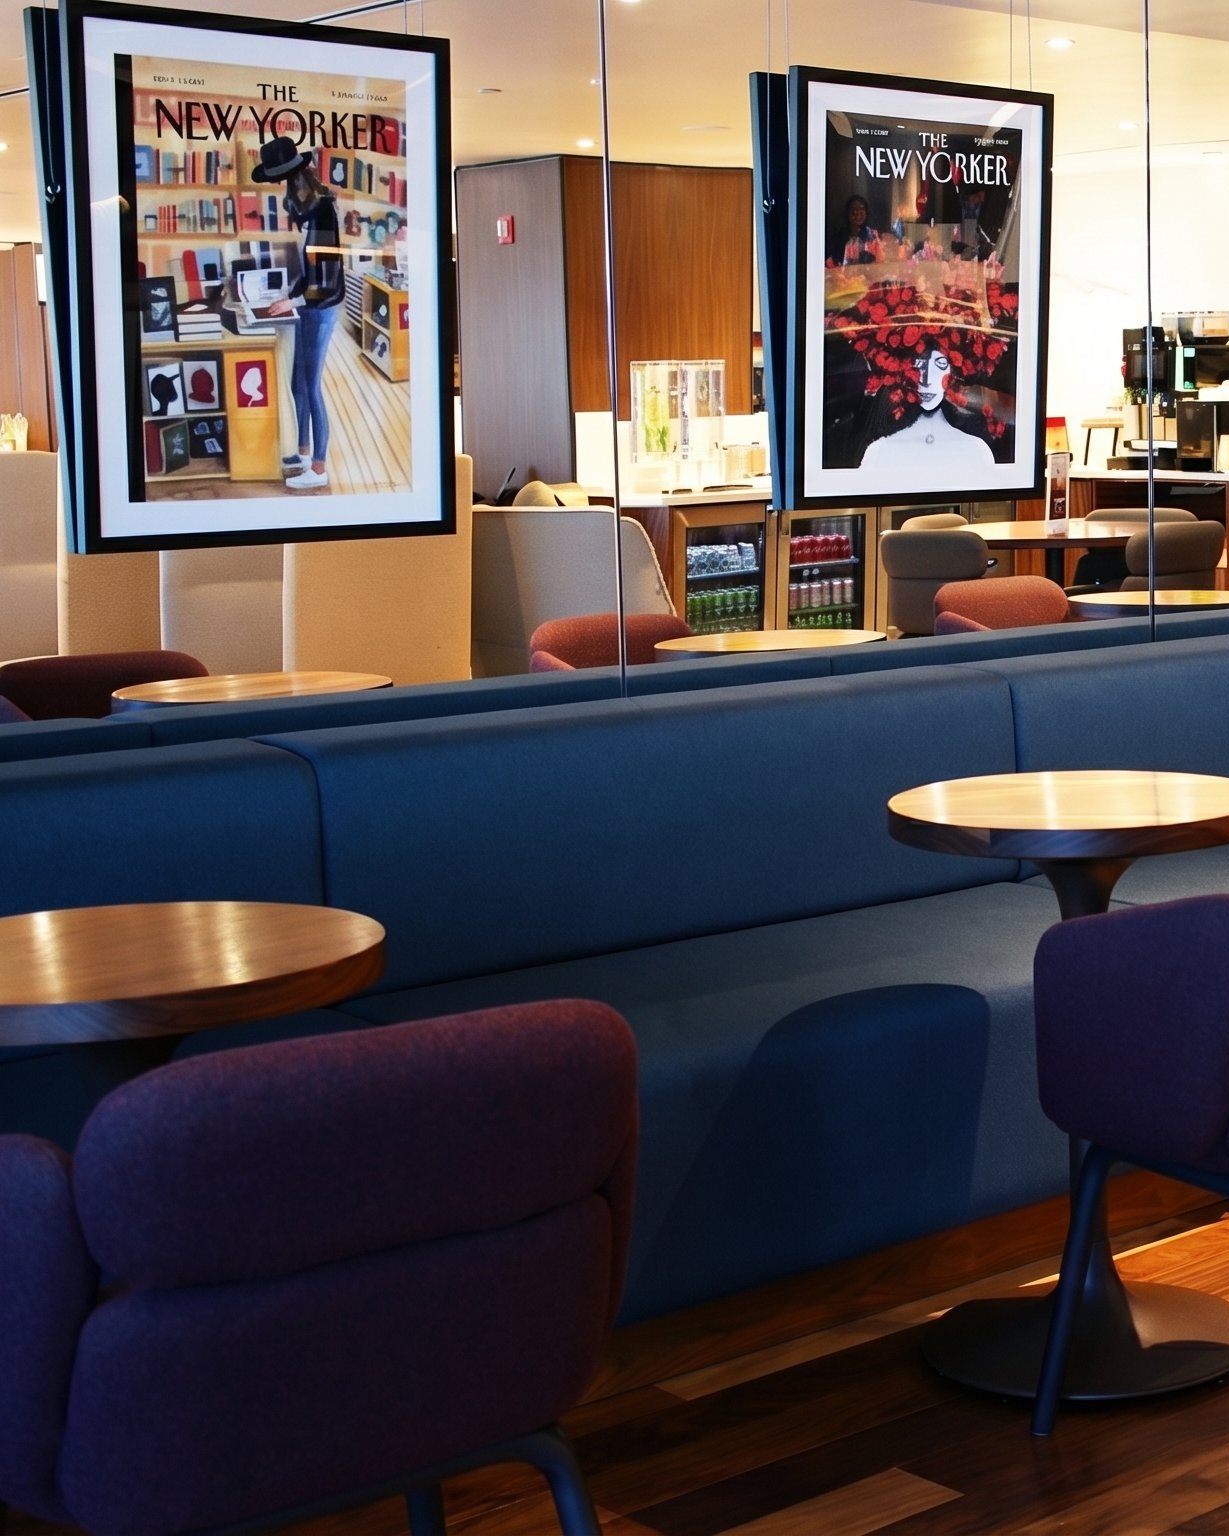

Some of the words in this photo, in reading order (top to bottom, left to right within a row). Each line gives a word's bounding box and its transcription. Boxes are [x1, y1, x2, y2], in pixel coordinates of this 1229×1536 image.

[256, 83, 300, 103] THE
[154, 98, 243, 142] NEW
[248, 105, 392, 154] YORKER
[918, 131, 949, 149] THE
[855, 145, 913, 180] NEW
[915, 150, 1011, 187] YORKER
